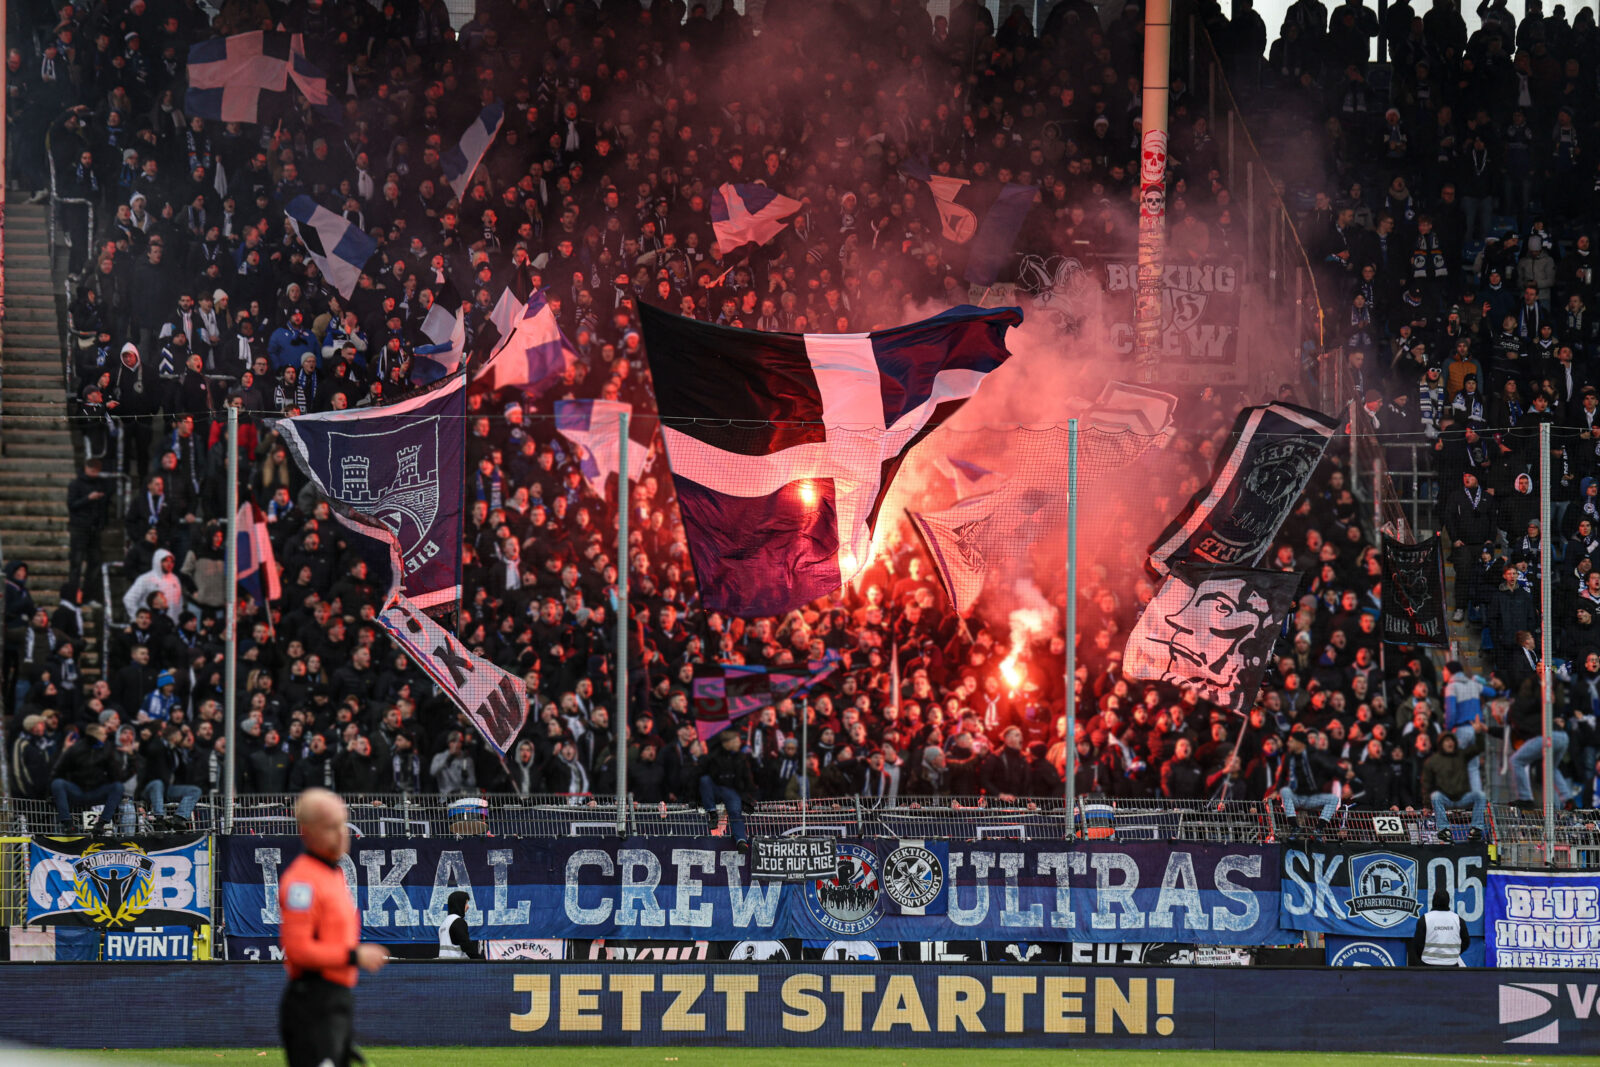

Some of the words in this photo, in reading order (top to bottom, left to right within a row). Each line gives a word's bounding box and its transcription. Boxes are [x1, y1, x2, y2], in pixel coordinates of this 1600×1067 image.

[1109, 322, 1232, 357] CEW
[1376, 819, 1400, 832] 26
[756, 857, 784, 871] JEDE
[786, 855, 835, 871] AUFLAGE
[758, 842, 808, 857] STÄRKER
[810, 841, 831, 856] ALS
[890, 848, 936, 865] SEKTION
[254, 848, 532, 927] LKAL
[563, 848, 783, 928] CREW
[885, 875, 942, 907] STADIONVERBOT
[948, 850, 1262, 932] ULTRAS
[1283, 848, 1348, 921] SK
[1427, 855, 1484, 923] 05
[1356, 898, 1415, 911] SPARRENKOLLEKTIV
[1506, 885, 1599, 921] BLUE
[820, 915, 876, 932] BIELEFELD
[107, 935, 189, 957] AVANTI
[1498, 951, 1600, 968] BIELEFEL
[509, 973, 759, 1032] JETZT
[780, 973, 1175, 1036] STARTEN!
[1566, 983, 1600, 1018] V
